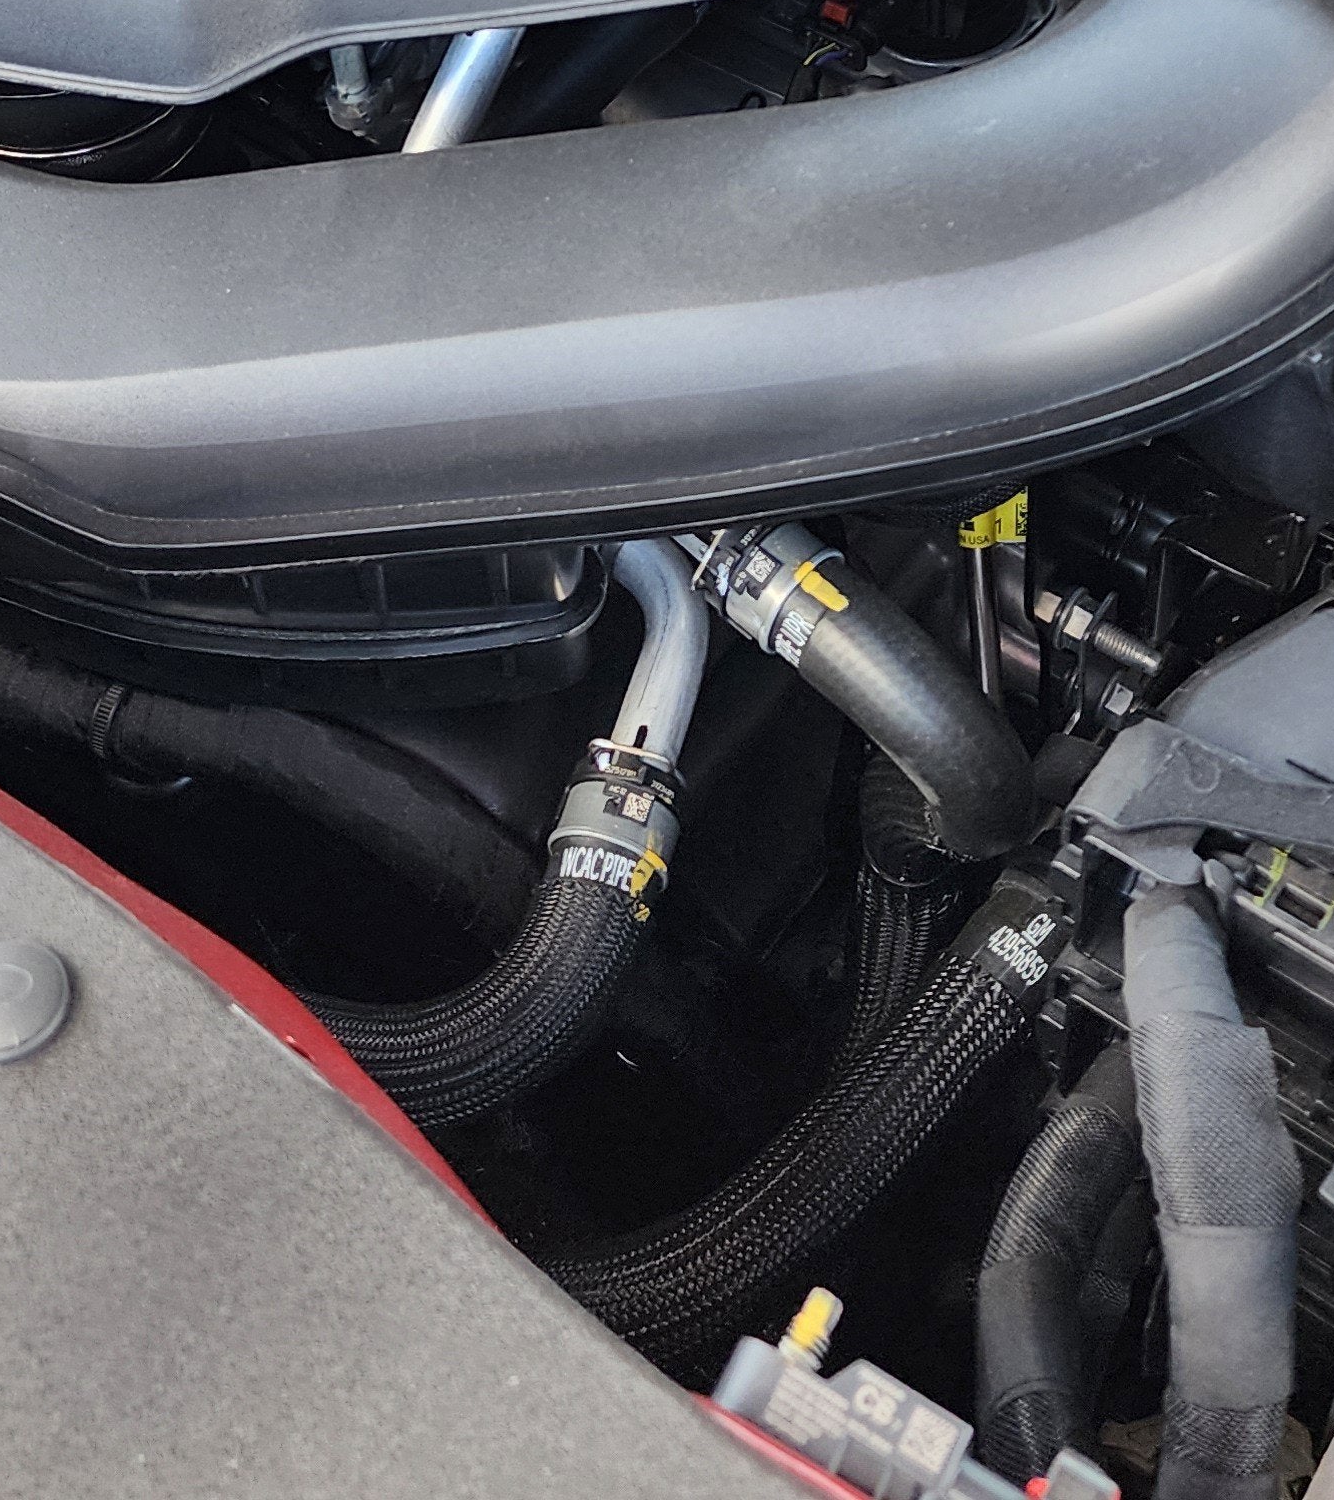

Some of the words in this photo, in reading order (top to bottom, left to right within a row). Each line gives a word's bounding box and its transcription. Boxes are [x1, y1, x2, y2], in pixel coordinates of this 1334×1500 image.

[969, 534, 990, 545] USA
[780, 610, 816, 648] UPR
[559, 846, 604, 880] WCAC
[1024, 913, 1057, 943] GM
[987, 925, 1049, 986] 42956859
